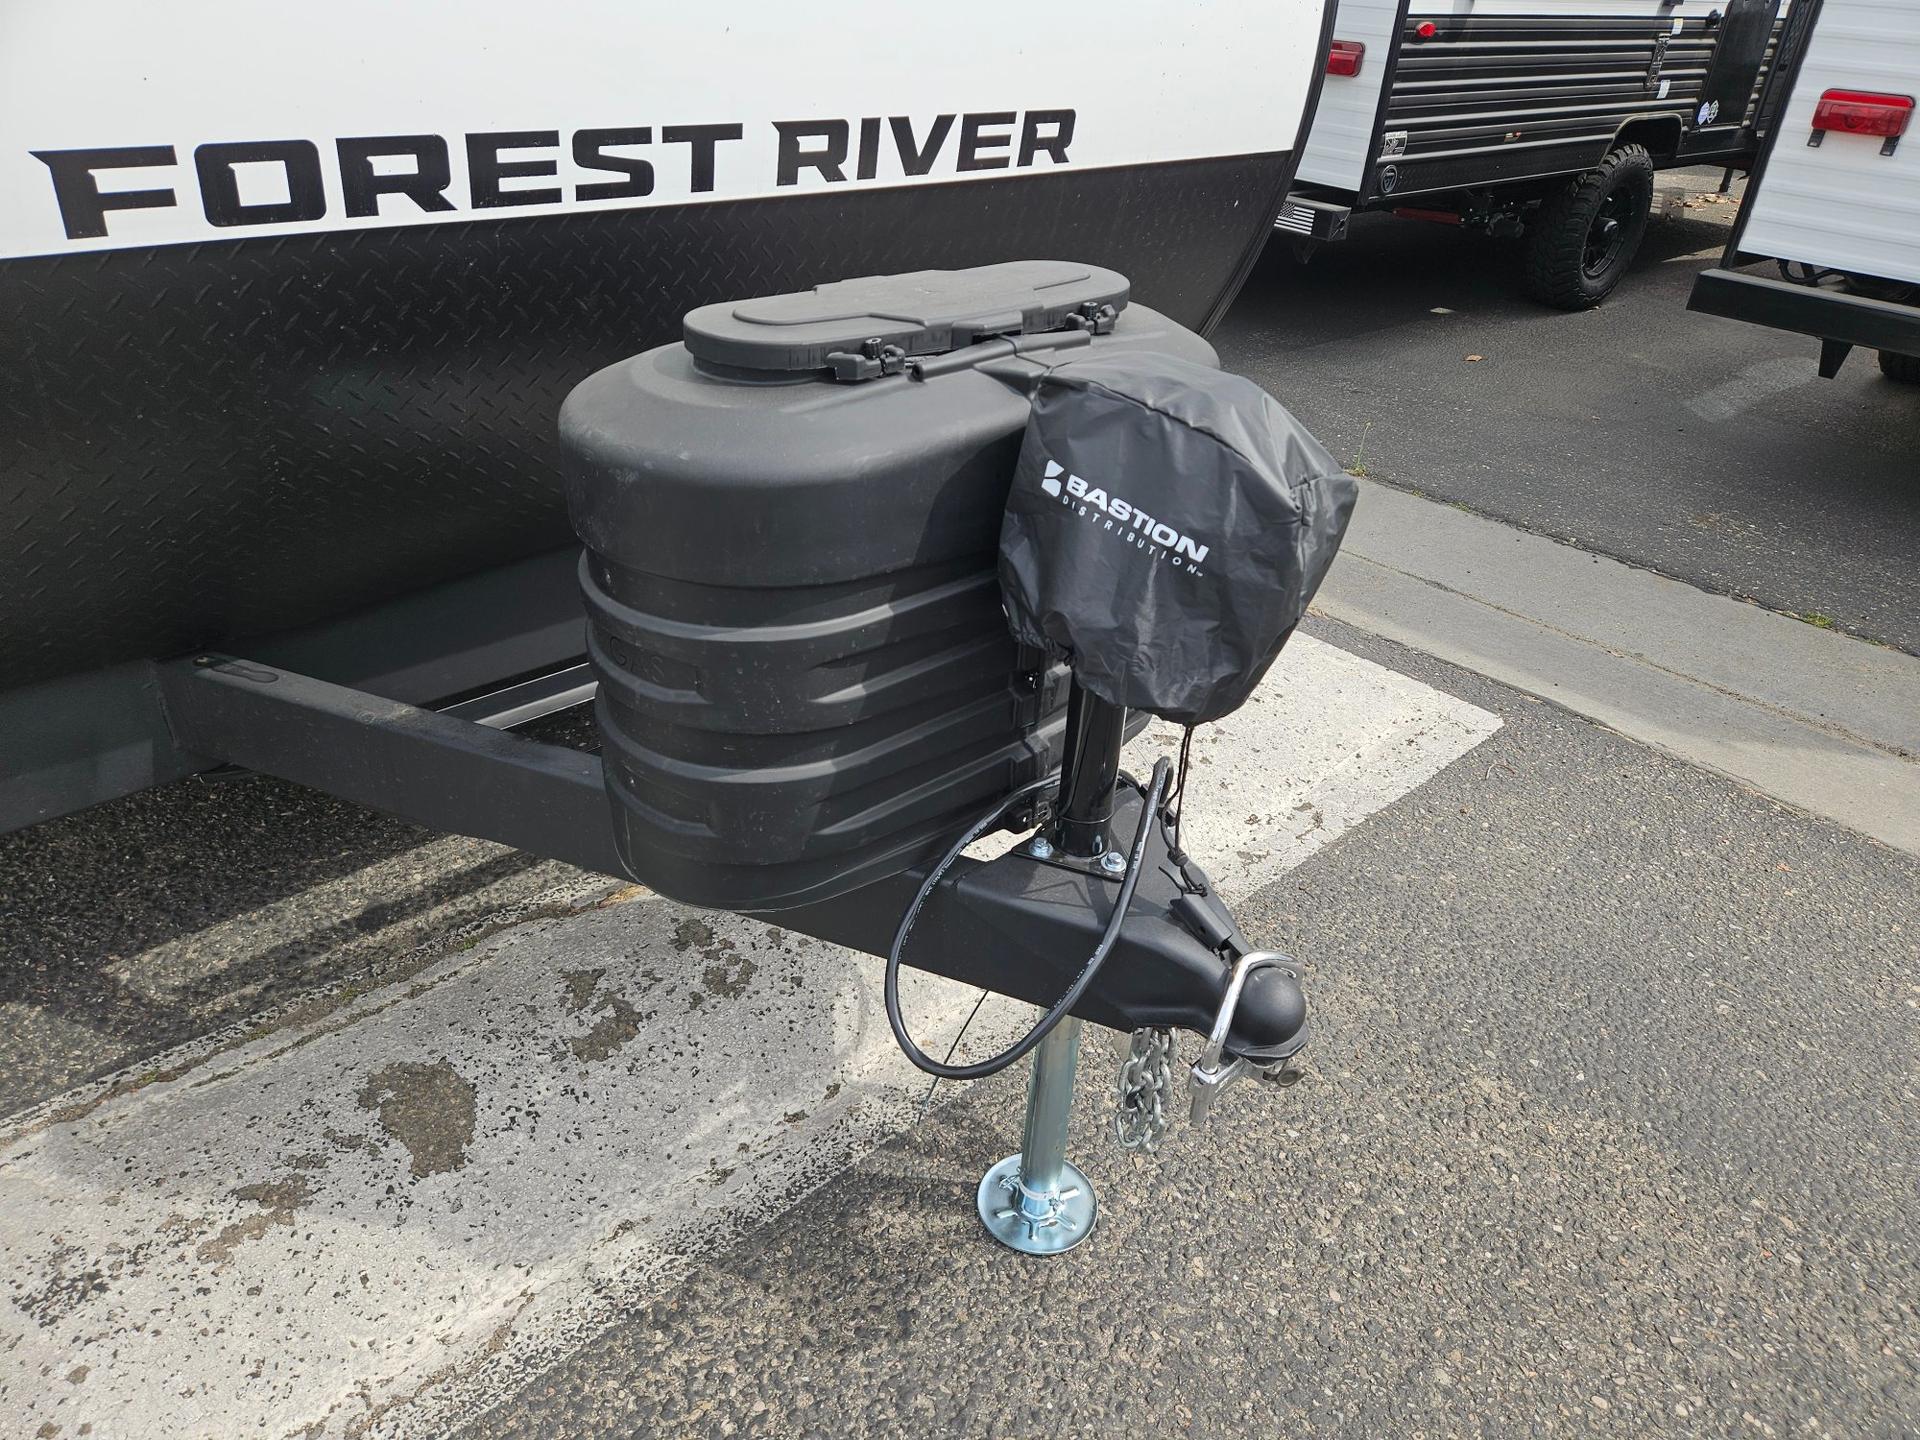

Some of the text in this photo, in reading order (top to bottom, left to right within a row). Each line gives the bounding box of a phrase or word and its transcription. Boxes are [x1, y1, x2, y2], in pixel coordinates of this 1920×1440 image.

[29, 108, 1076, 239] FOREST RIVER
[1066, 474, 1209, 562] BASTION
